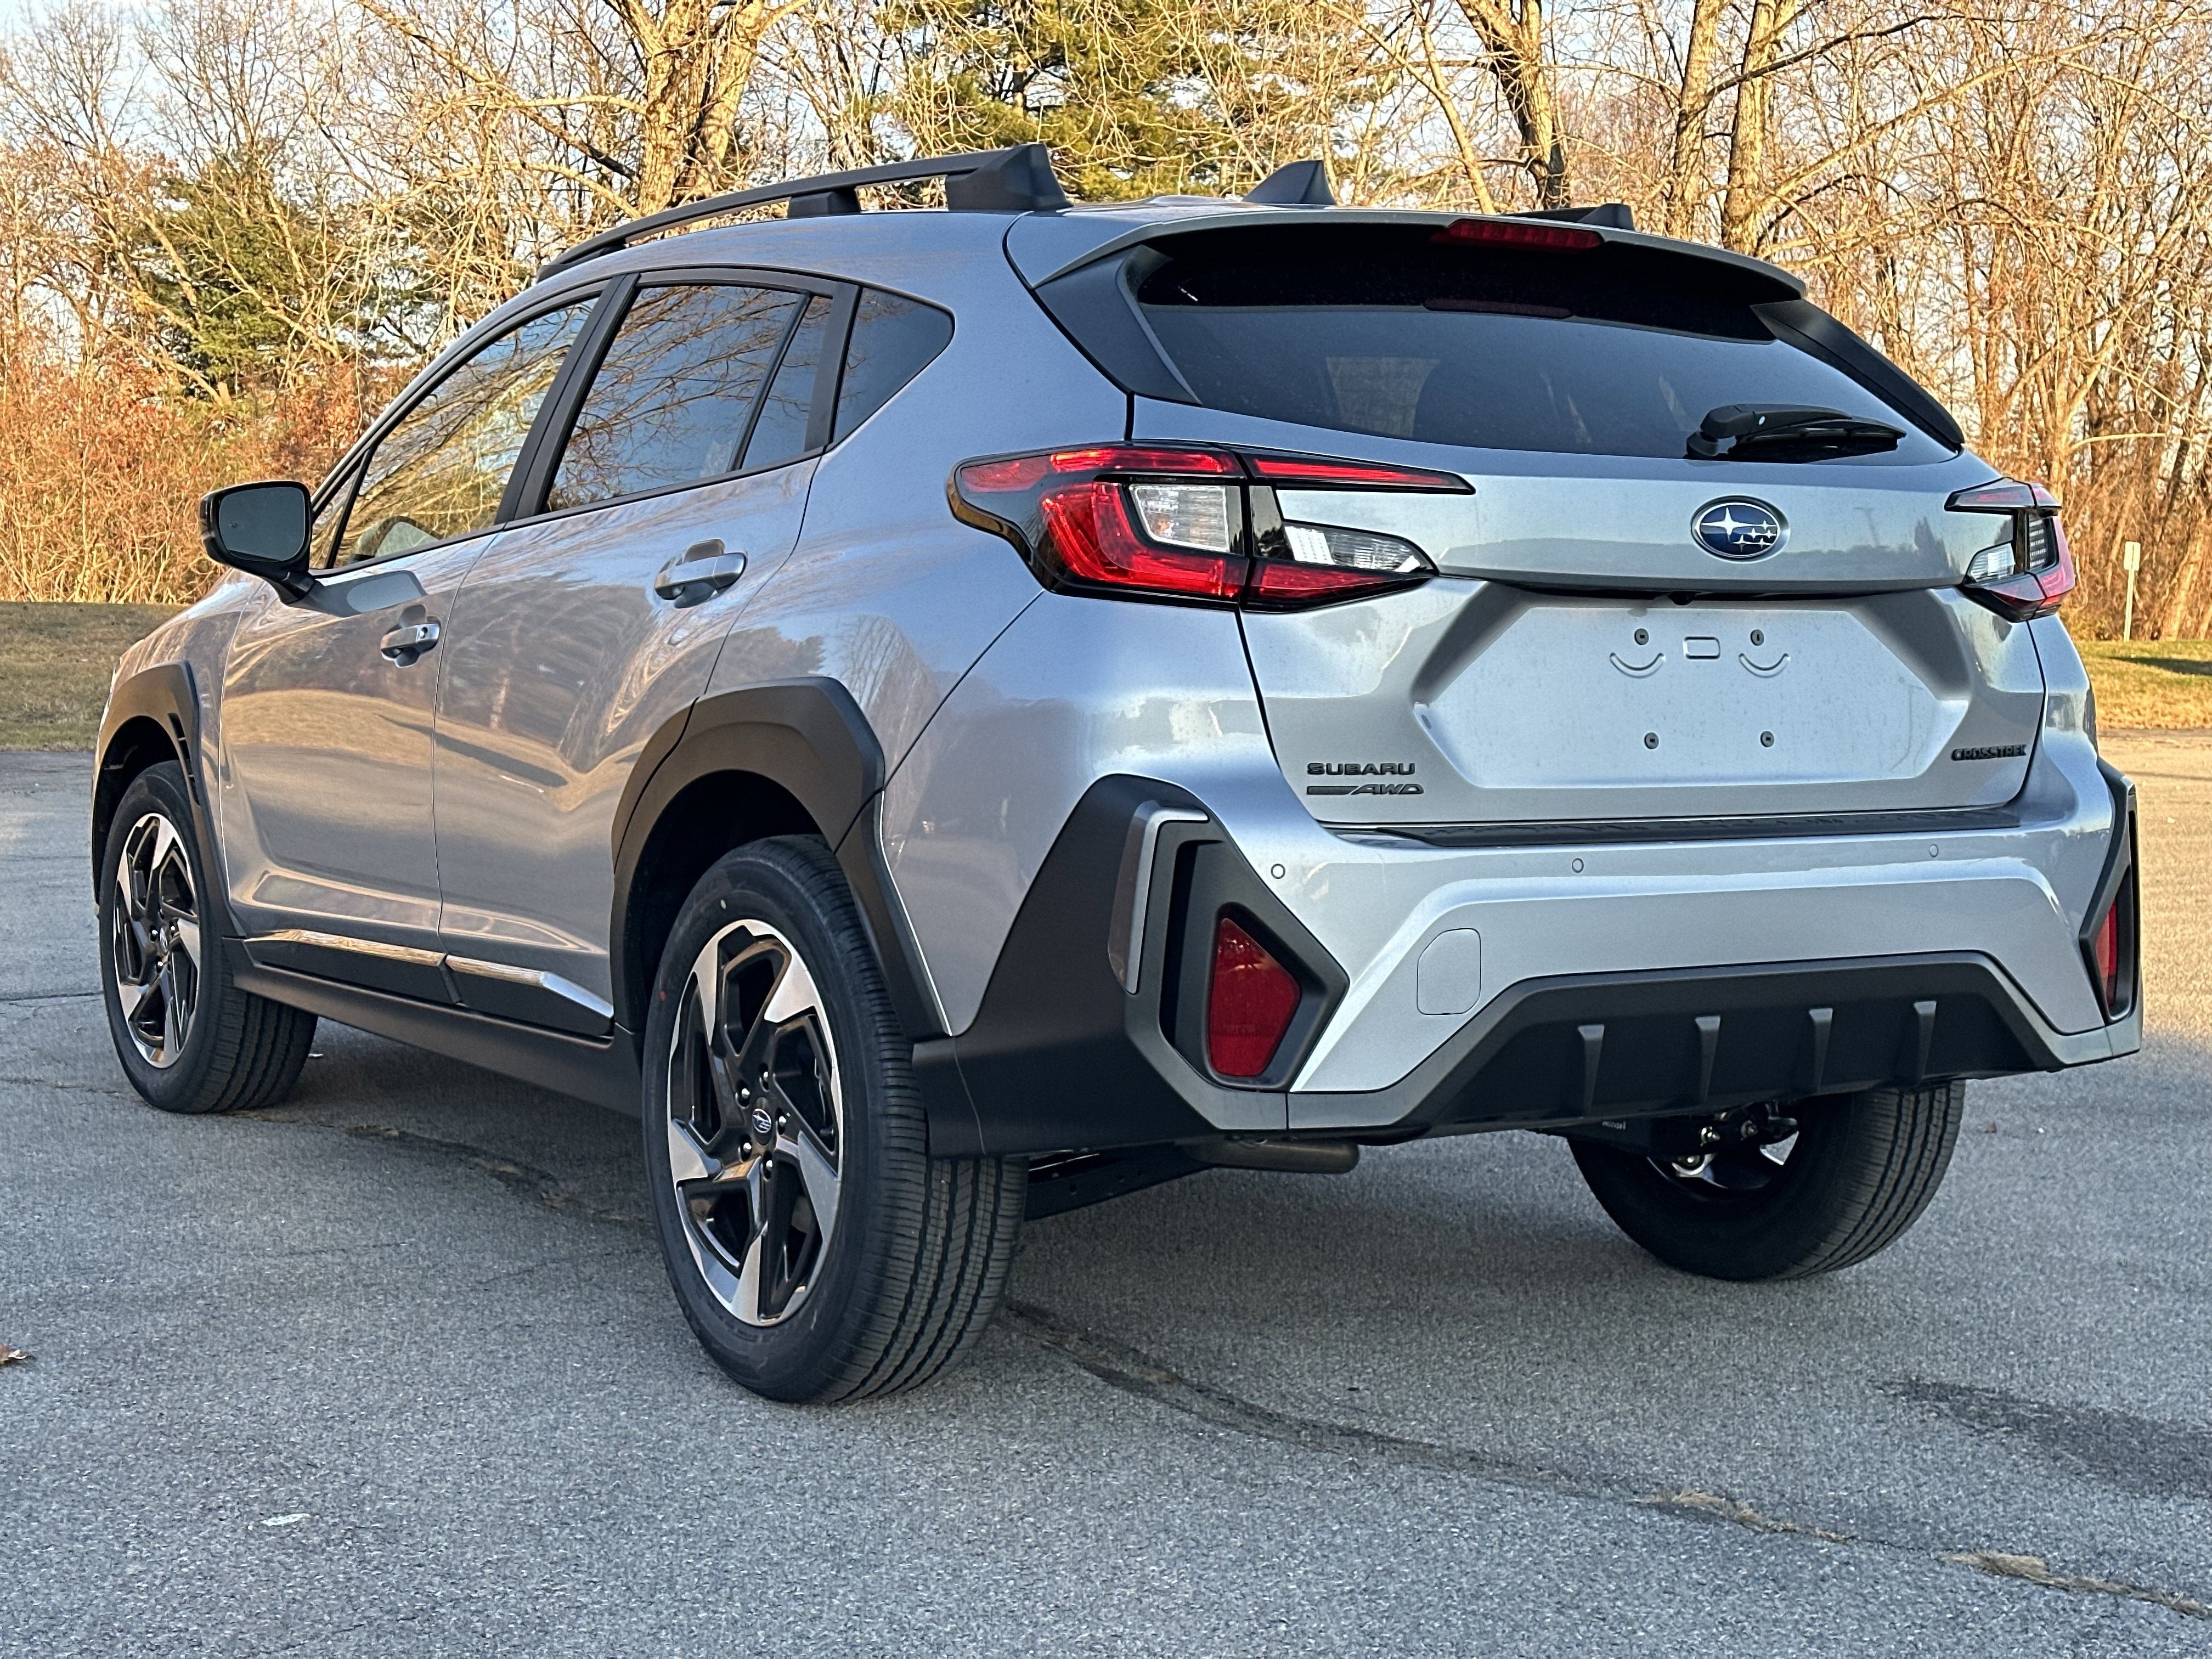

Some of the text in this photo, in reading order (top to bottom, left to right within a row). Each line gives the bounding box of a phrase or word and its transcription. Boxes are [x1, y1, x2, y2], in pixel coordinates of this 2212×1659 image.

[1951, 744, 2027, 761] CROSSTREK
[1307, 763, 1415, 775] SUBARU
[1351, 783, 1424, 795] AWD
